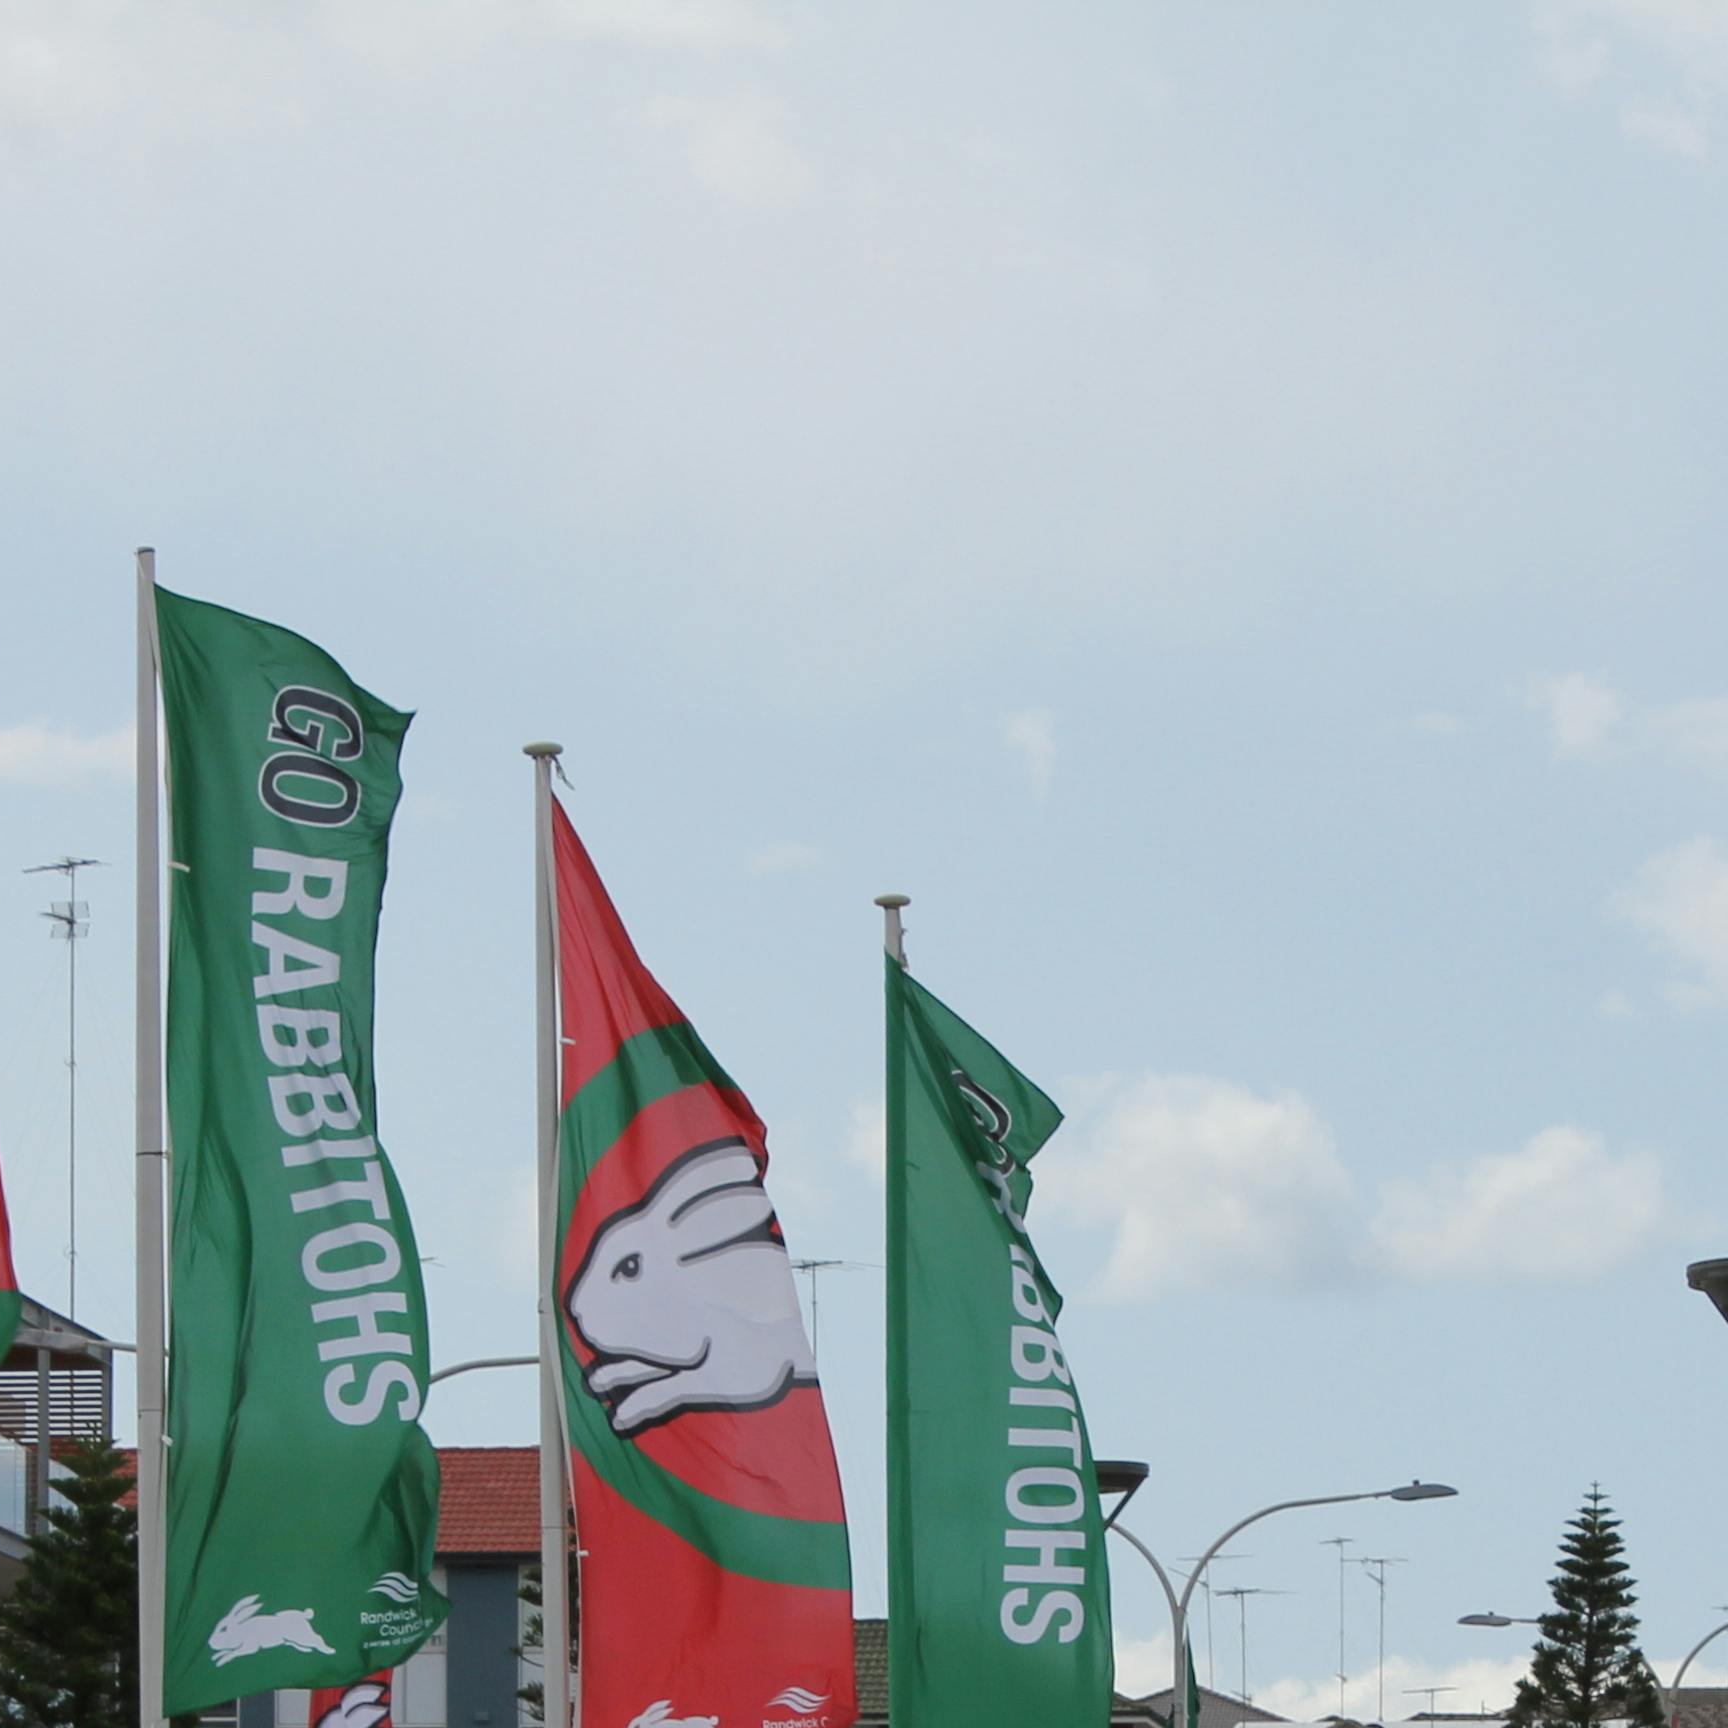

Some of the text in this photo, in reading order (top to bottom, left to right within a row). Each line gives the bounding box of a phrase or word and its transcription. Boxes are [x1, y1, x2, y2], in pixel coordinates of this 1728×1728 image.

[251, 685, 421, 1426] GO RABBITOHS
[360, 1608, 418, 1625] Randwick
